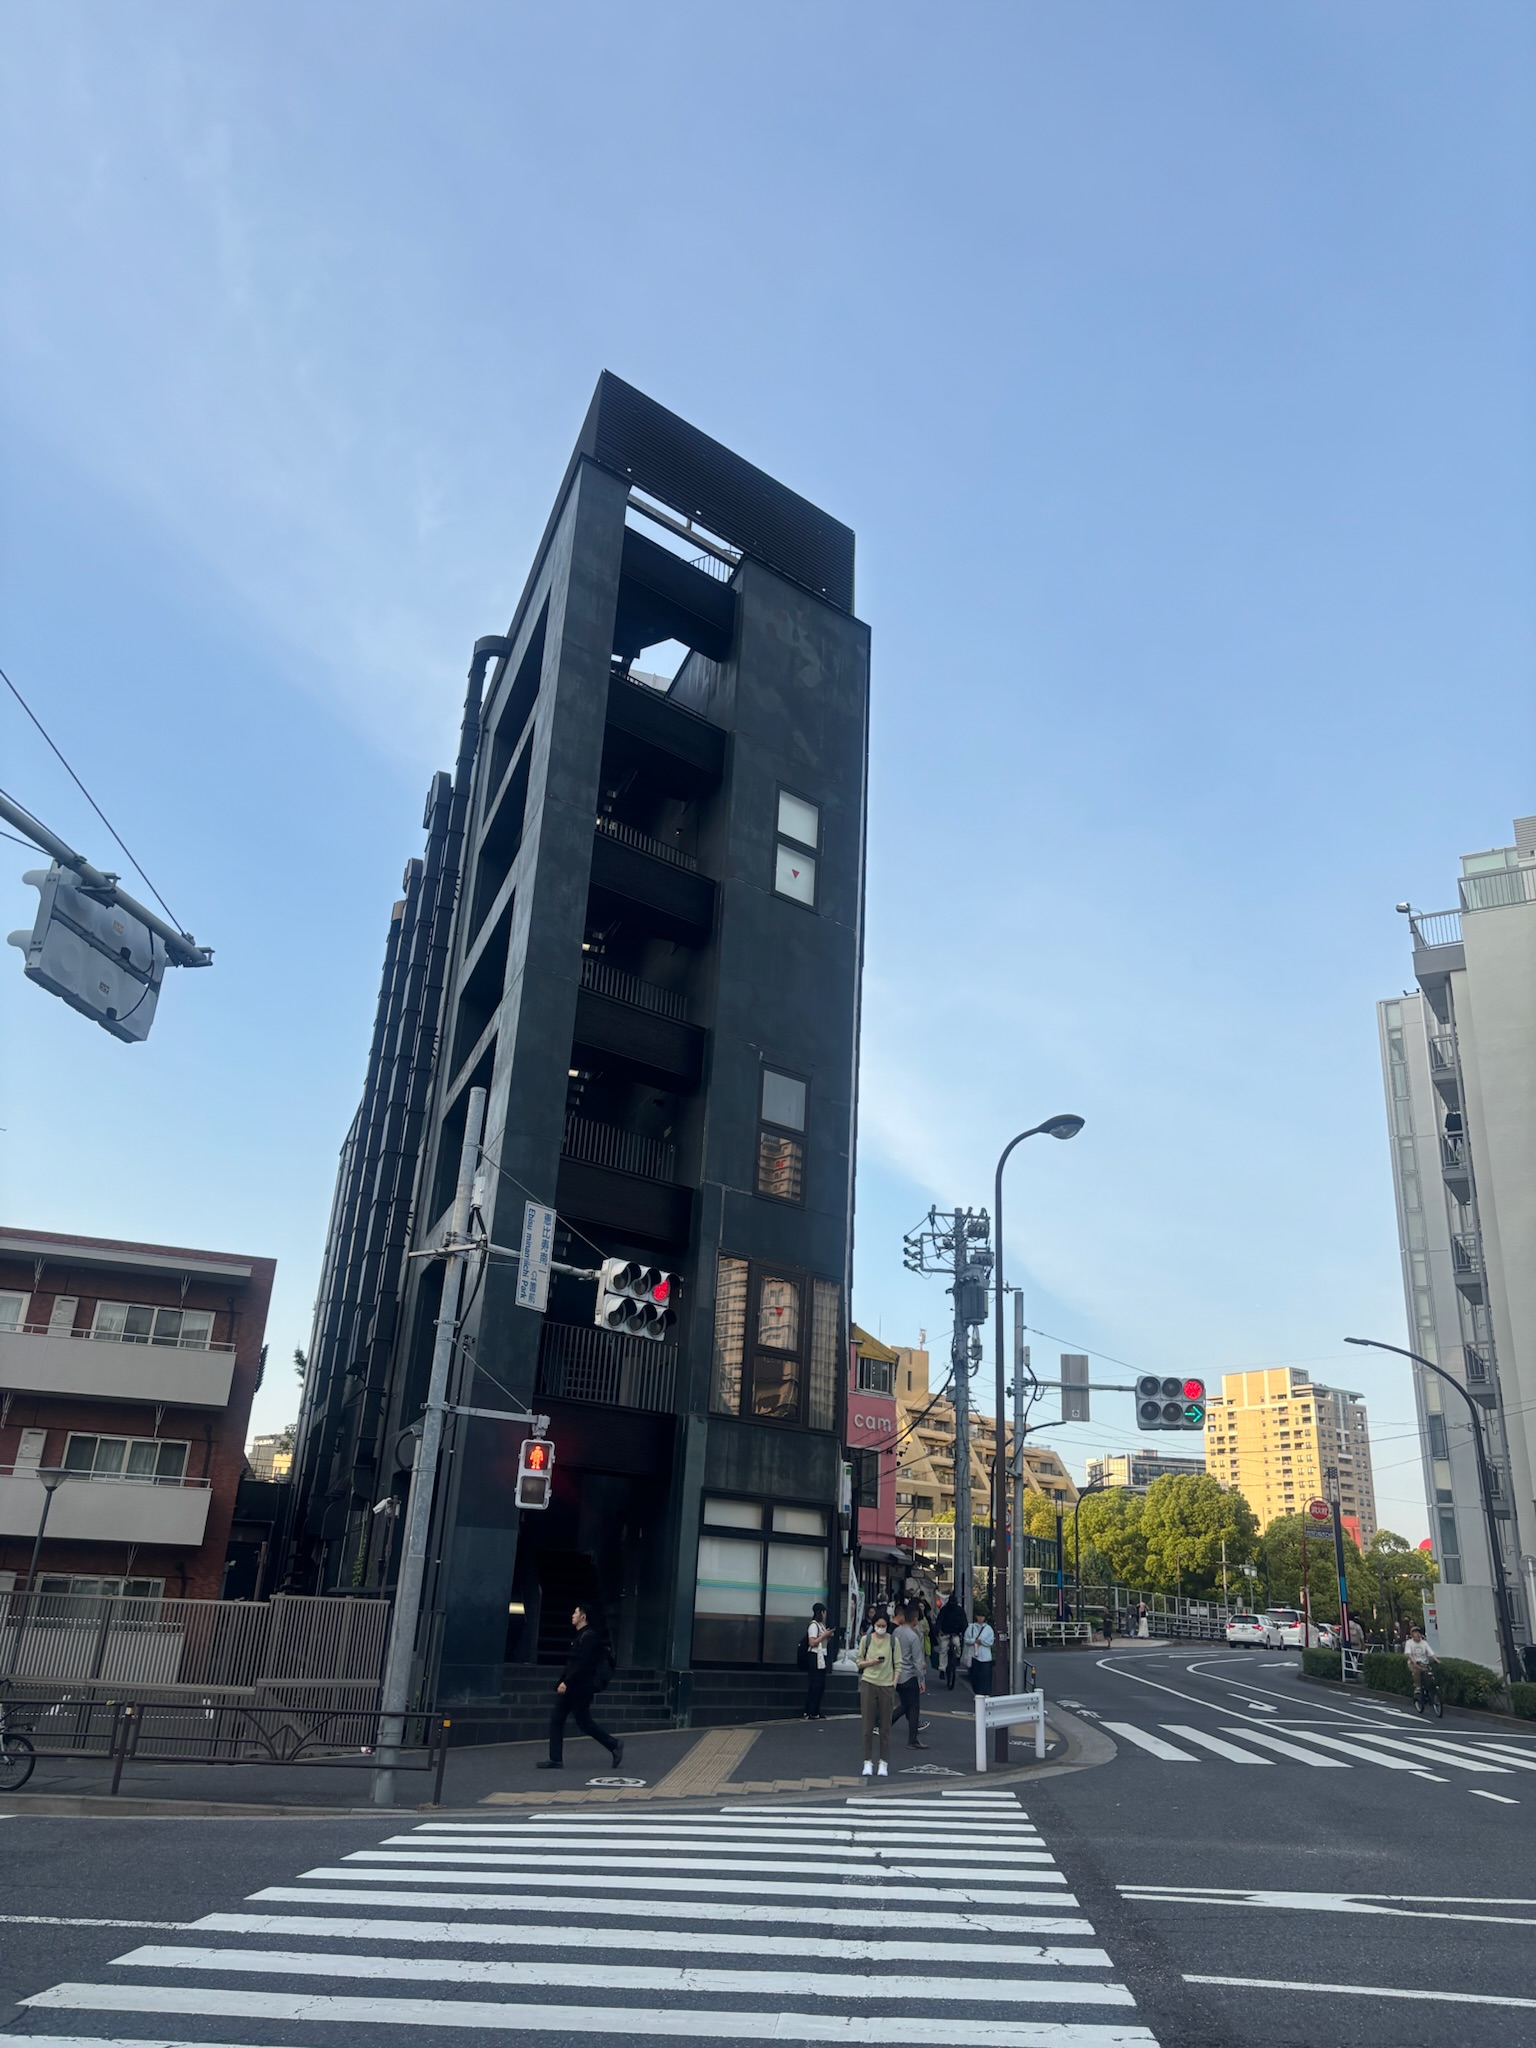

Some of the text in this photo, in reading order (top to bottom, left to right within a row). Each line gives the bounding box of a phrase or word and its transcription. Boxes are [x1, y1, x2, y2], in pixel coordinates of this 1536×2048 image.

[520, 1208, 536, 1299] Ebisu minamiichi Park
[854, 1414, 892, 1433] cam
